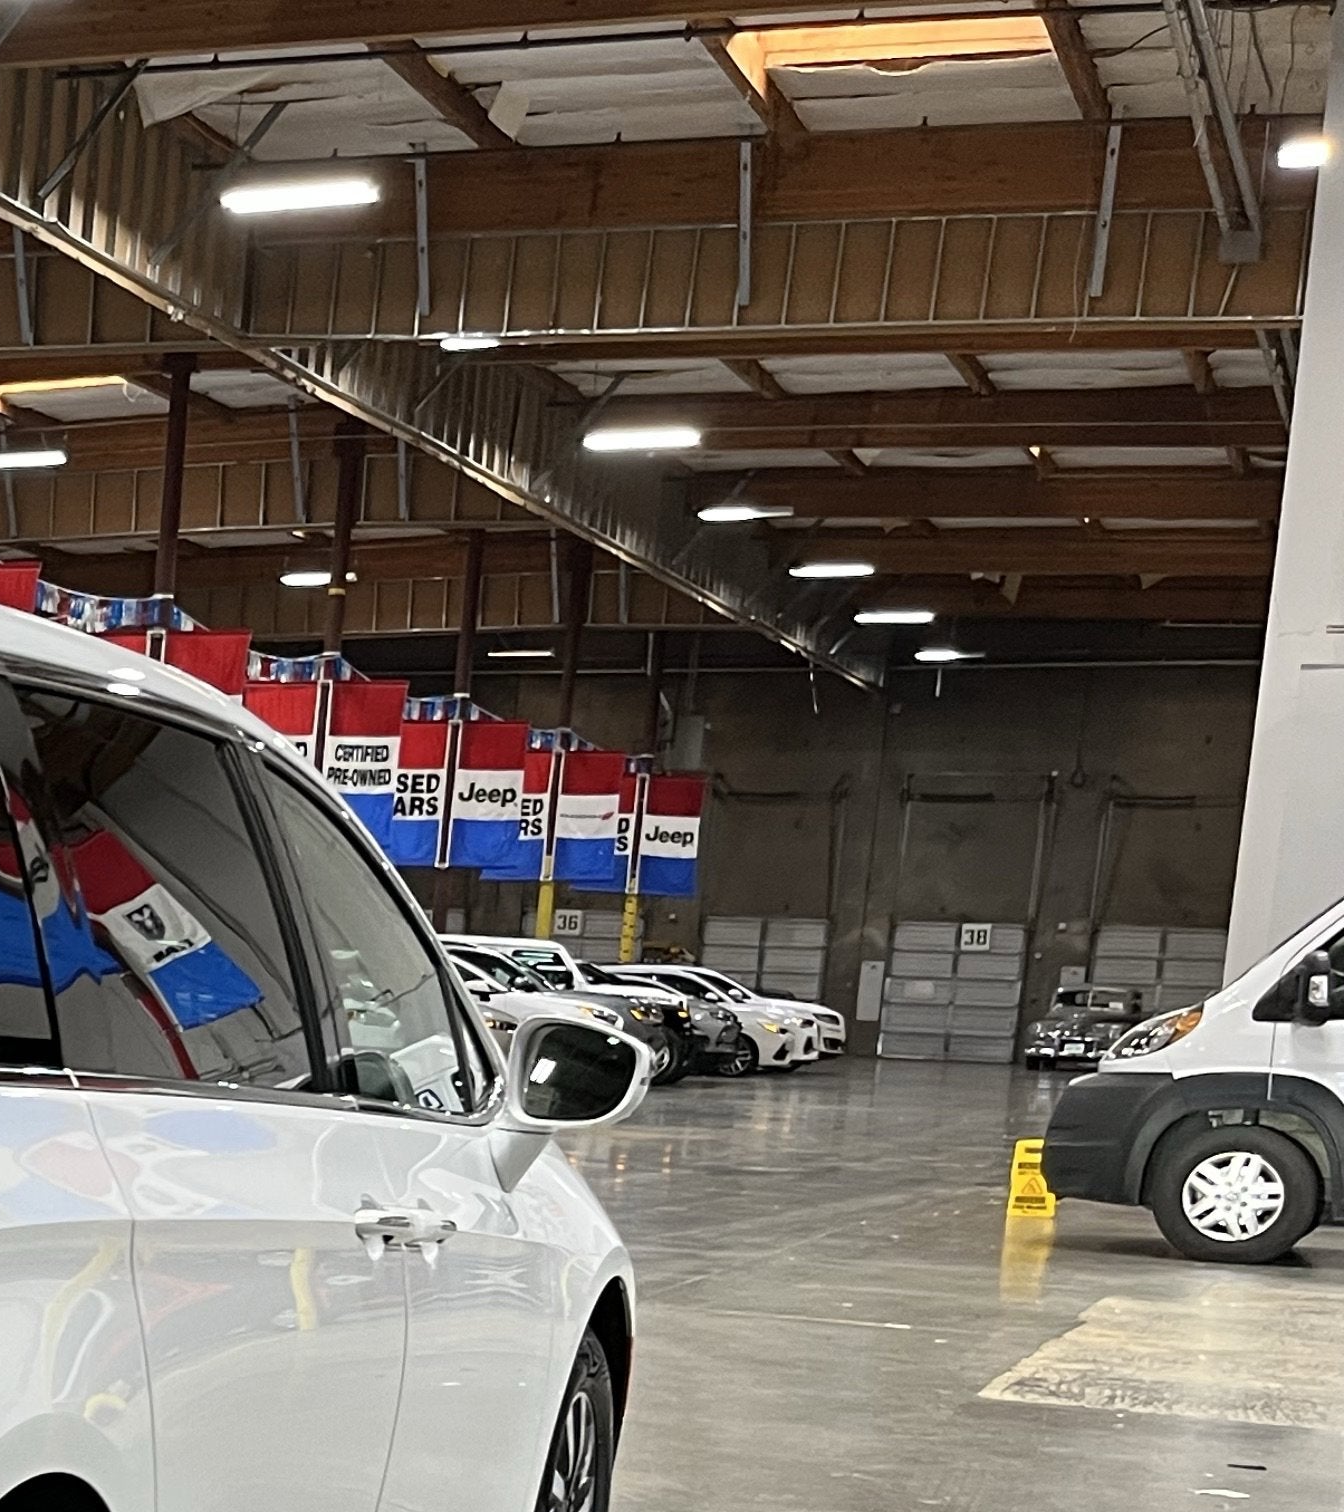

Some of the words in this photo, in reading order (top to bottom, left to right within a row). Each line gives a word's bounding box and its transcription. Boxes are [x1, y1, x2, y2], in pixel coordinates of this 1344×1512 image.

[335, 744, 389, 763] CERTIFIED
[326, 766, 391, 787] PRE-OWNED
[395, 773, 440, 794] SED
[458, 782, 516, 808] Jeep
[393, 796, 438, 817] ARS
[645, 825, 694, 848] Jeep
[557, 914, 578, 930] 36
[964, 929, 988, 946] 38
